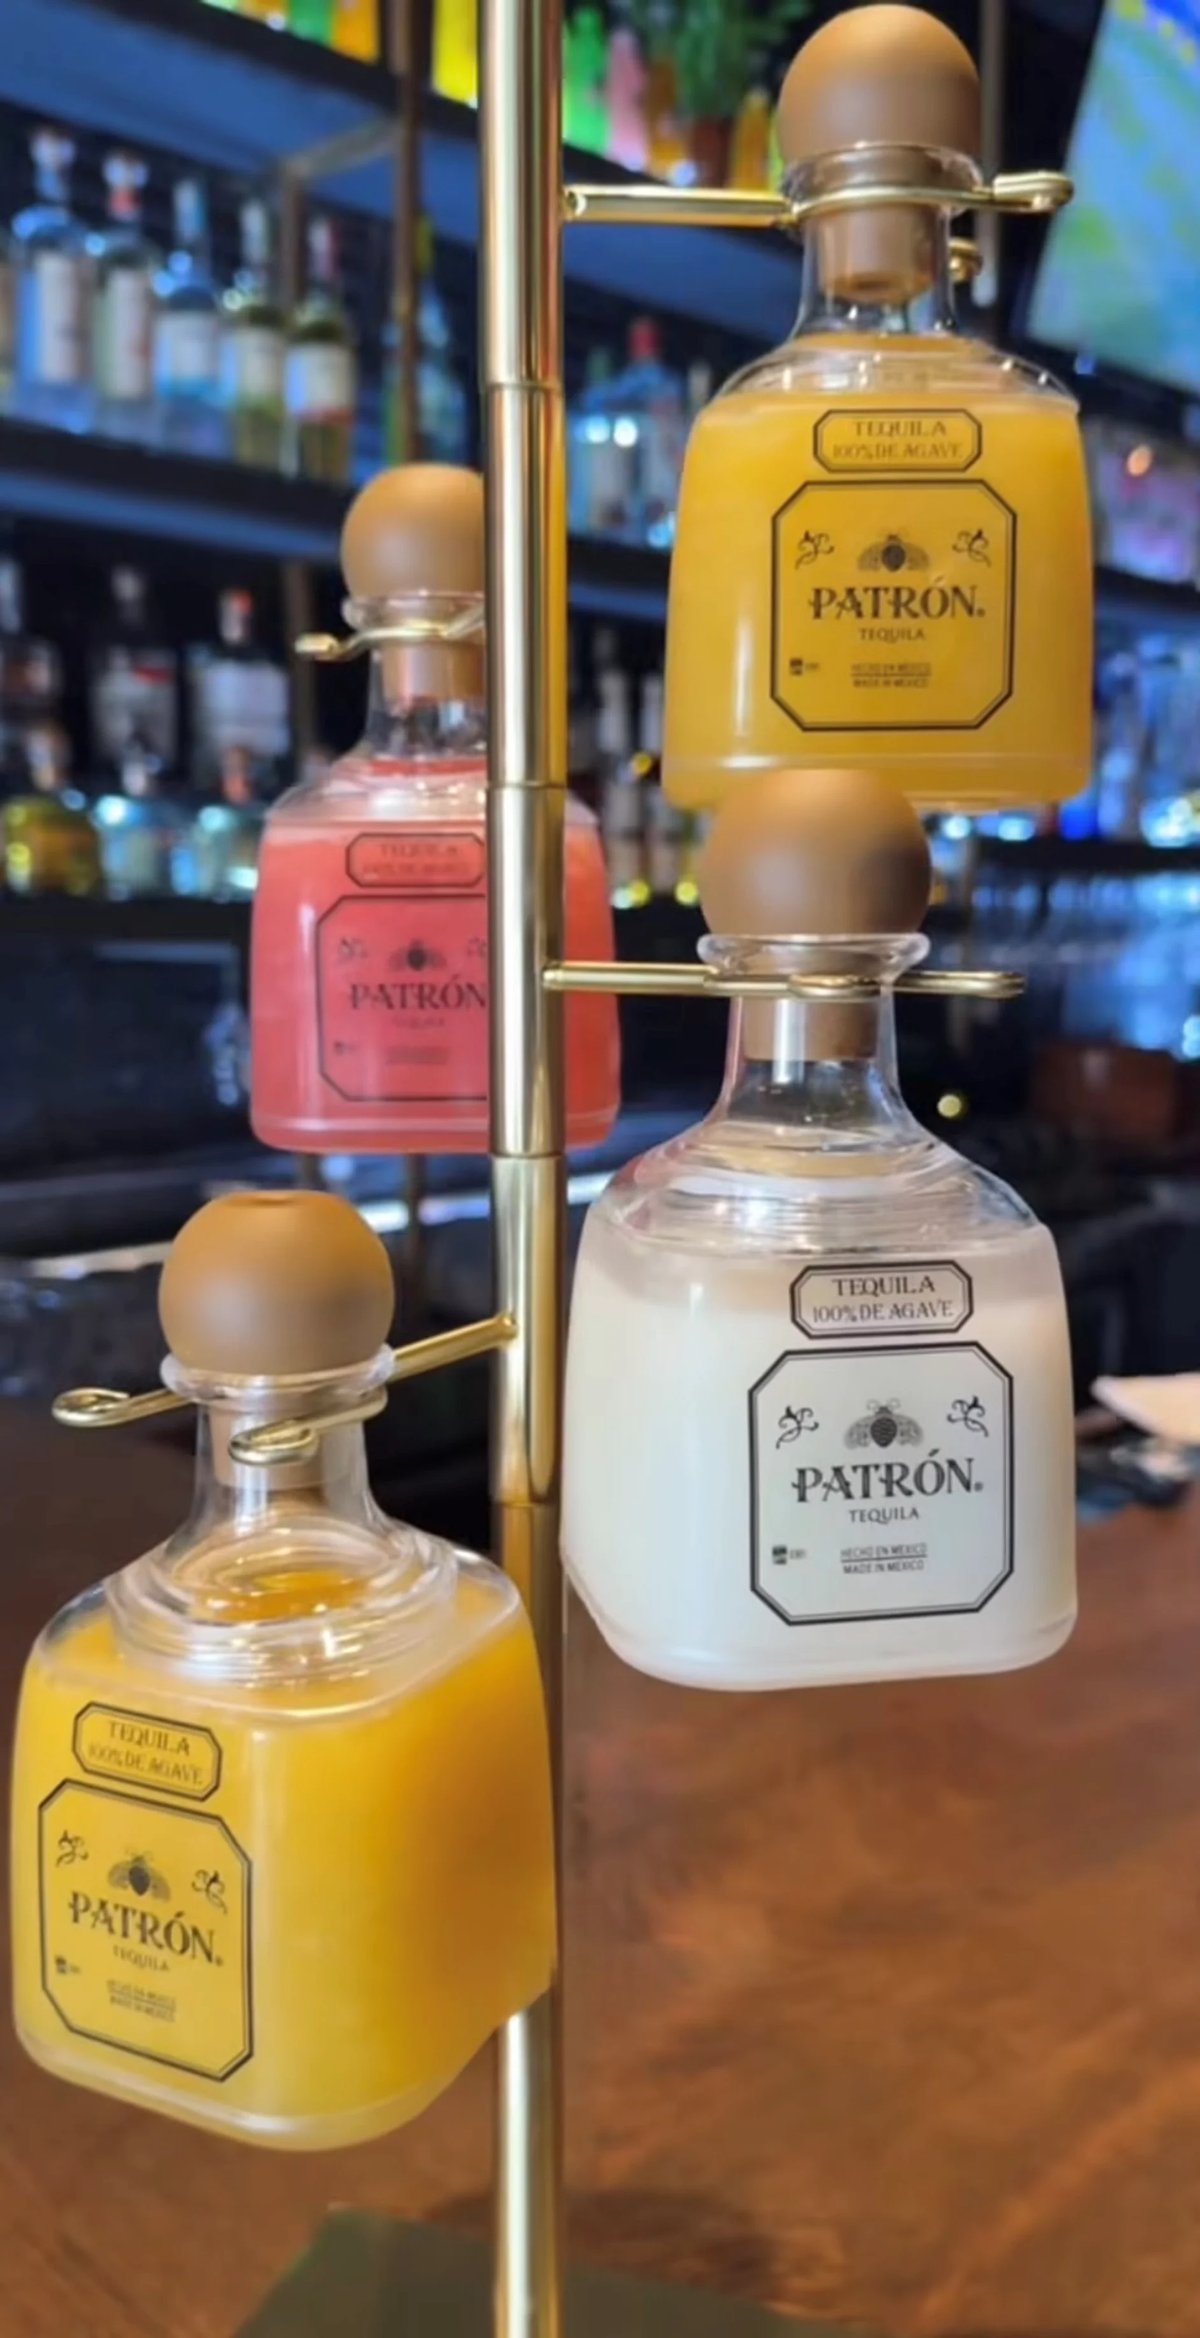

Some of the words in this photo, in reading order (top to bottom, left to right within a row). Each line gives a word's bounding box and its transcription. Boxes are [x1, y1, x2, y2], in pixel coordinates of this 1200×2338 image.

[854, 420, 947, 437] TEQUILA
[859, 627, 926, 643] TEQUILA
[832, 1276, 935, 1297] TEQUILA
[812, 1305, 857, 1322] 100%
[859, 1304, 885, 1320] DE
[889, 1301, 954, 1319] AGAVE
[849, 1507, 919, 1525] TEQUILA
[843, 1562, 872, 1574] MADE
[874, 1561, 885, 1573] IN
[109, 1721, 190, 1756] TEQUILA
